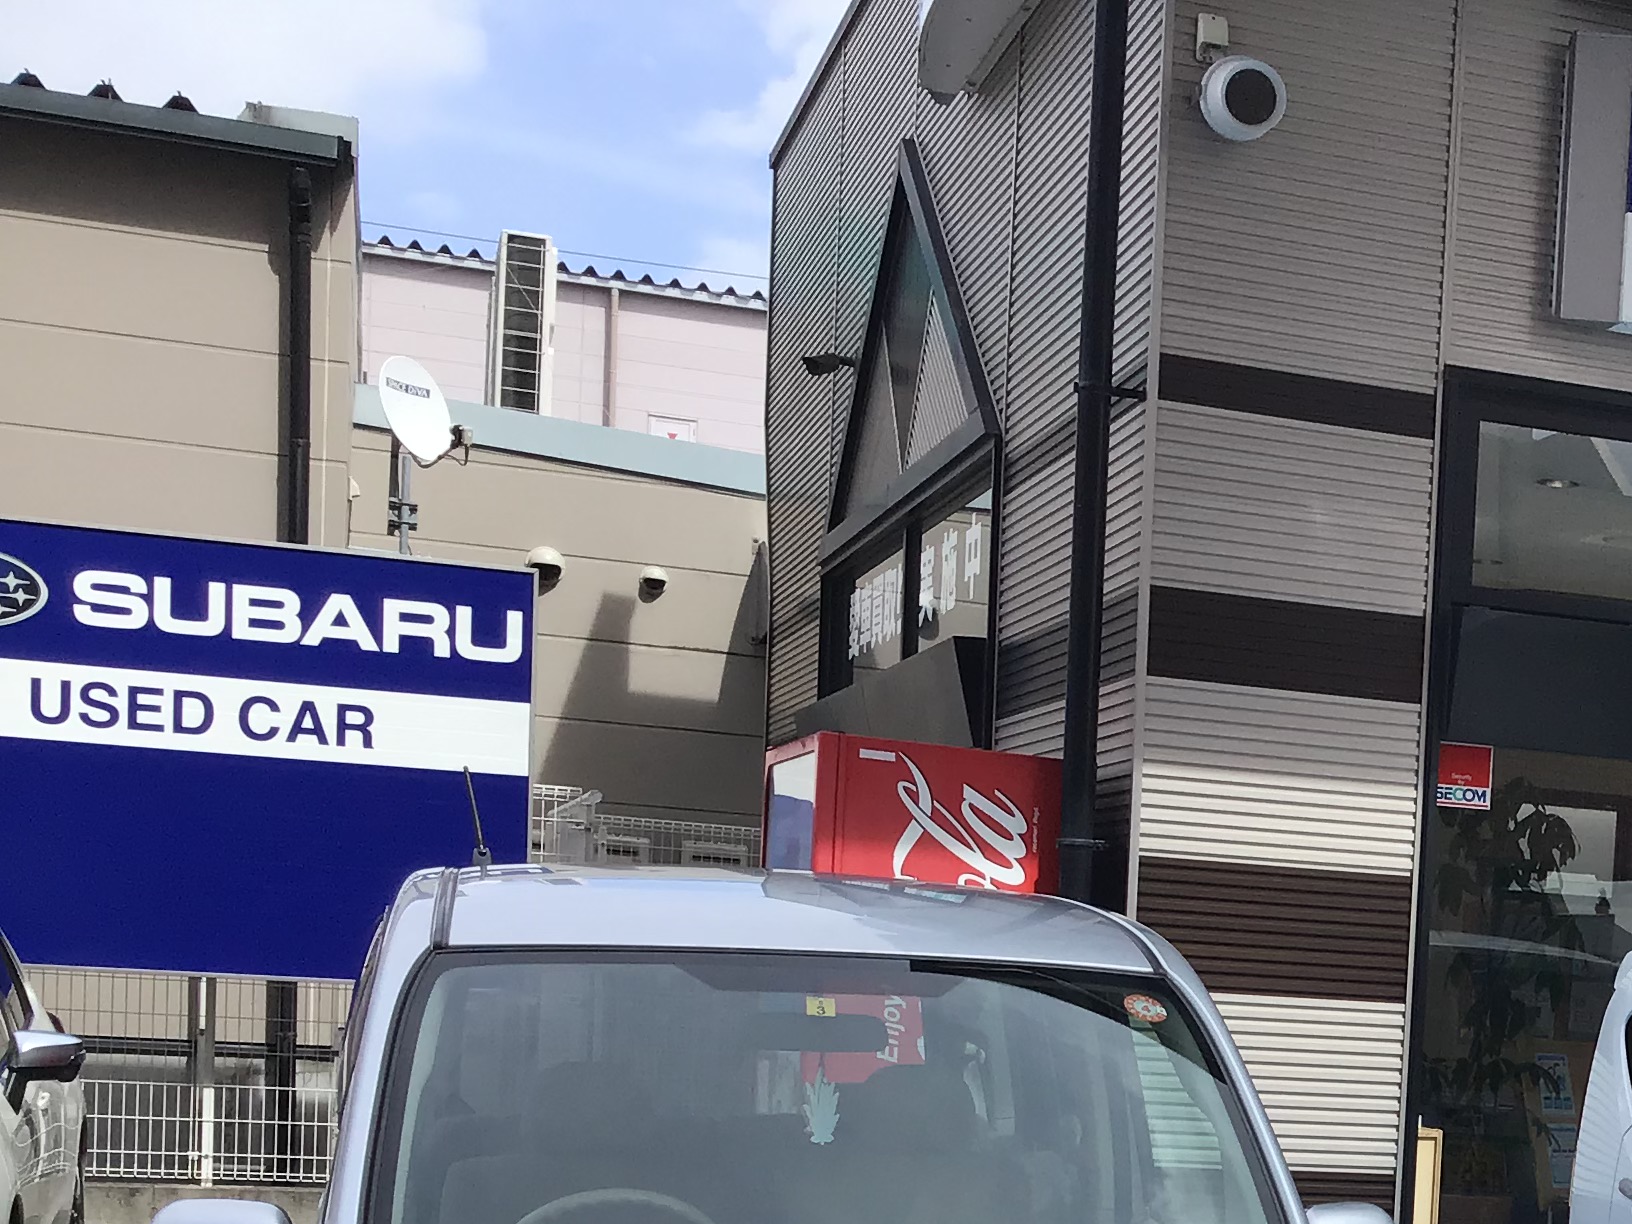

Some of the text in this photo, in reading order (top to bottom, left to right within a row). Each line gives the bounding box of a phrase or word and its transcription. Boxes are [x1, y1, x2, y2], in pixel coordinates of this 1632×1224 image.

[72, 569, 524, 664] SUBARU
[30, 677, 376, 750] USED CAR
[1436, 786, 1487, 804] SECOM
